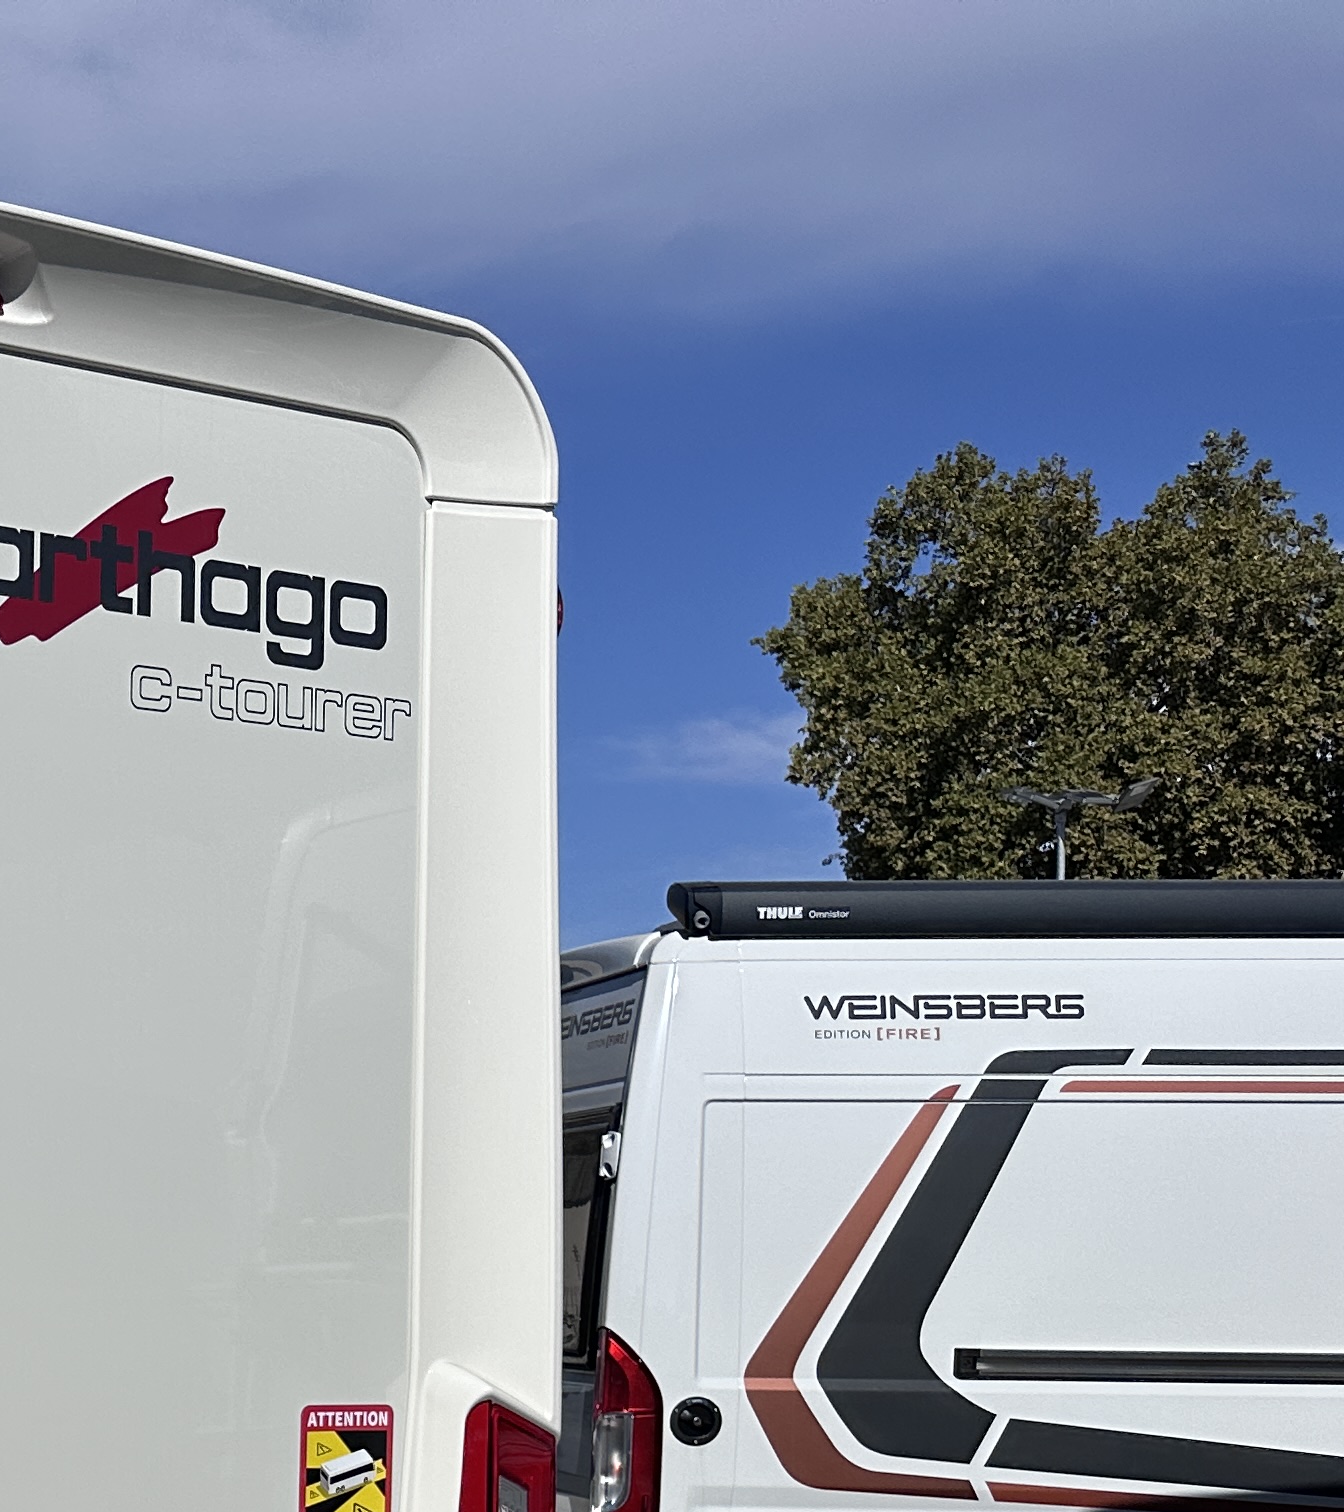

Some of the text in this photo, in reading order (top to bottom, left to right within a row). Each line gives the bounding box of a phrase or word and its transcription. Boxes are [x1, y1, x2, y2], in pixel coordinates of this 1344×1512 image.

[131, 664, 411, 741] c-tourer
[756, 906, 850, 919] THULE Omnistor
[803, 994, 1085, 1020] WEINSBERG
[814, 1027, 941, 1042] EDITION [FIRE]
[307, 1411, 388, 1428] ATTENTION
